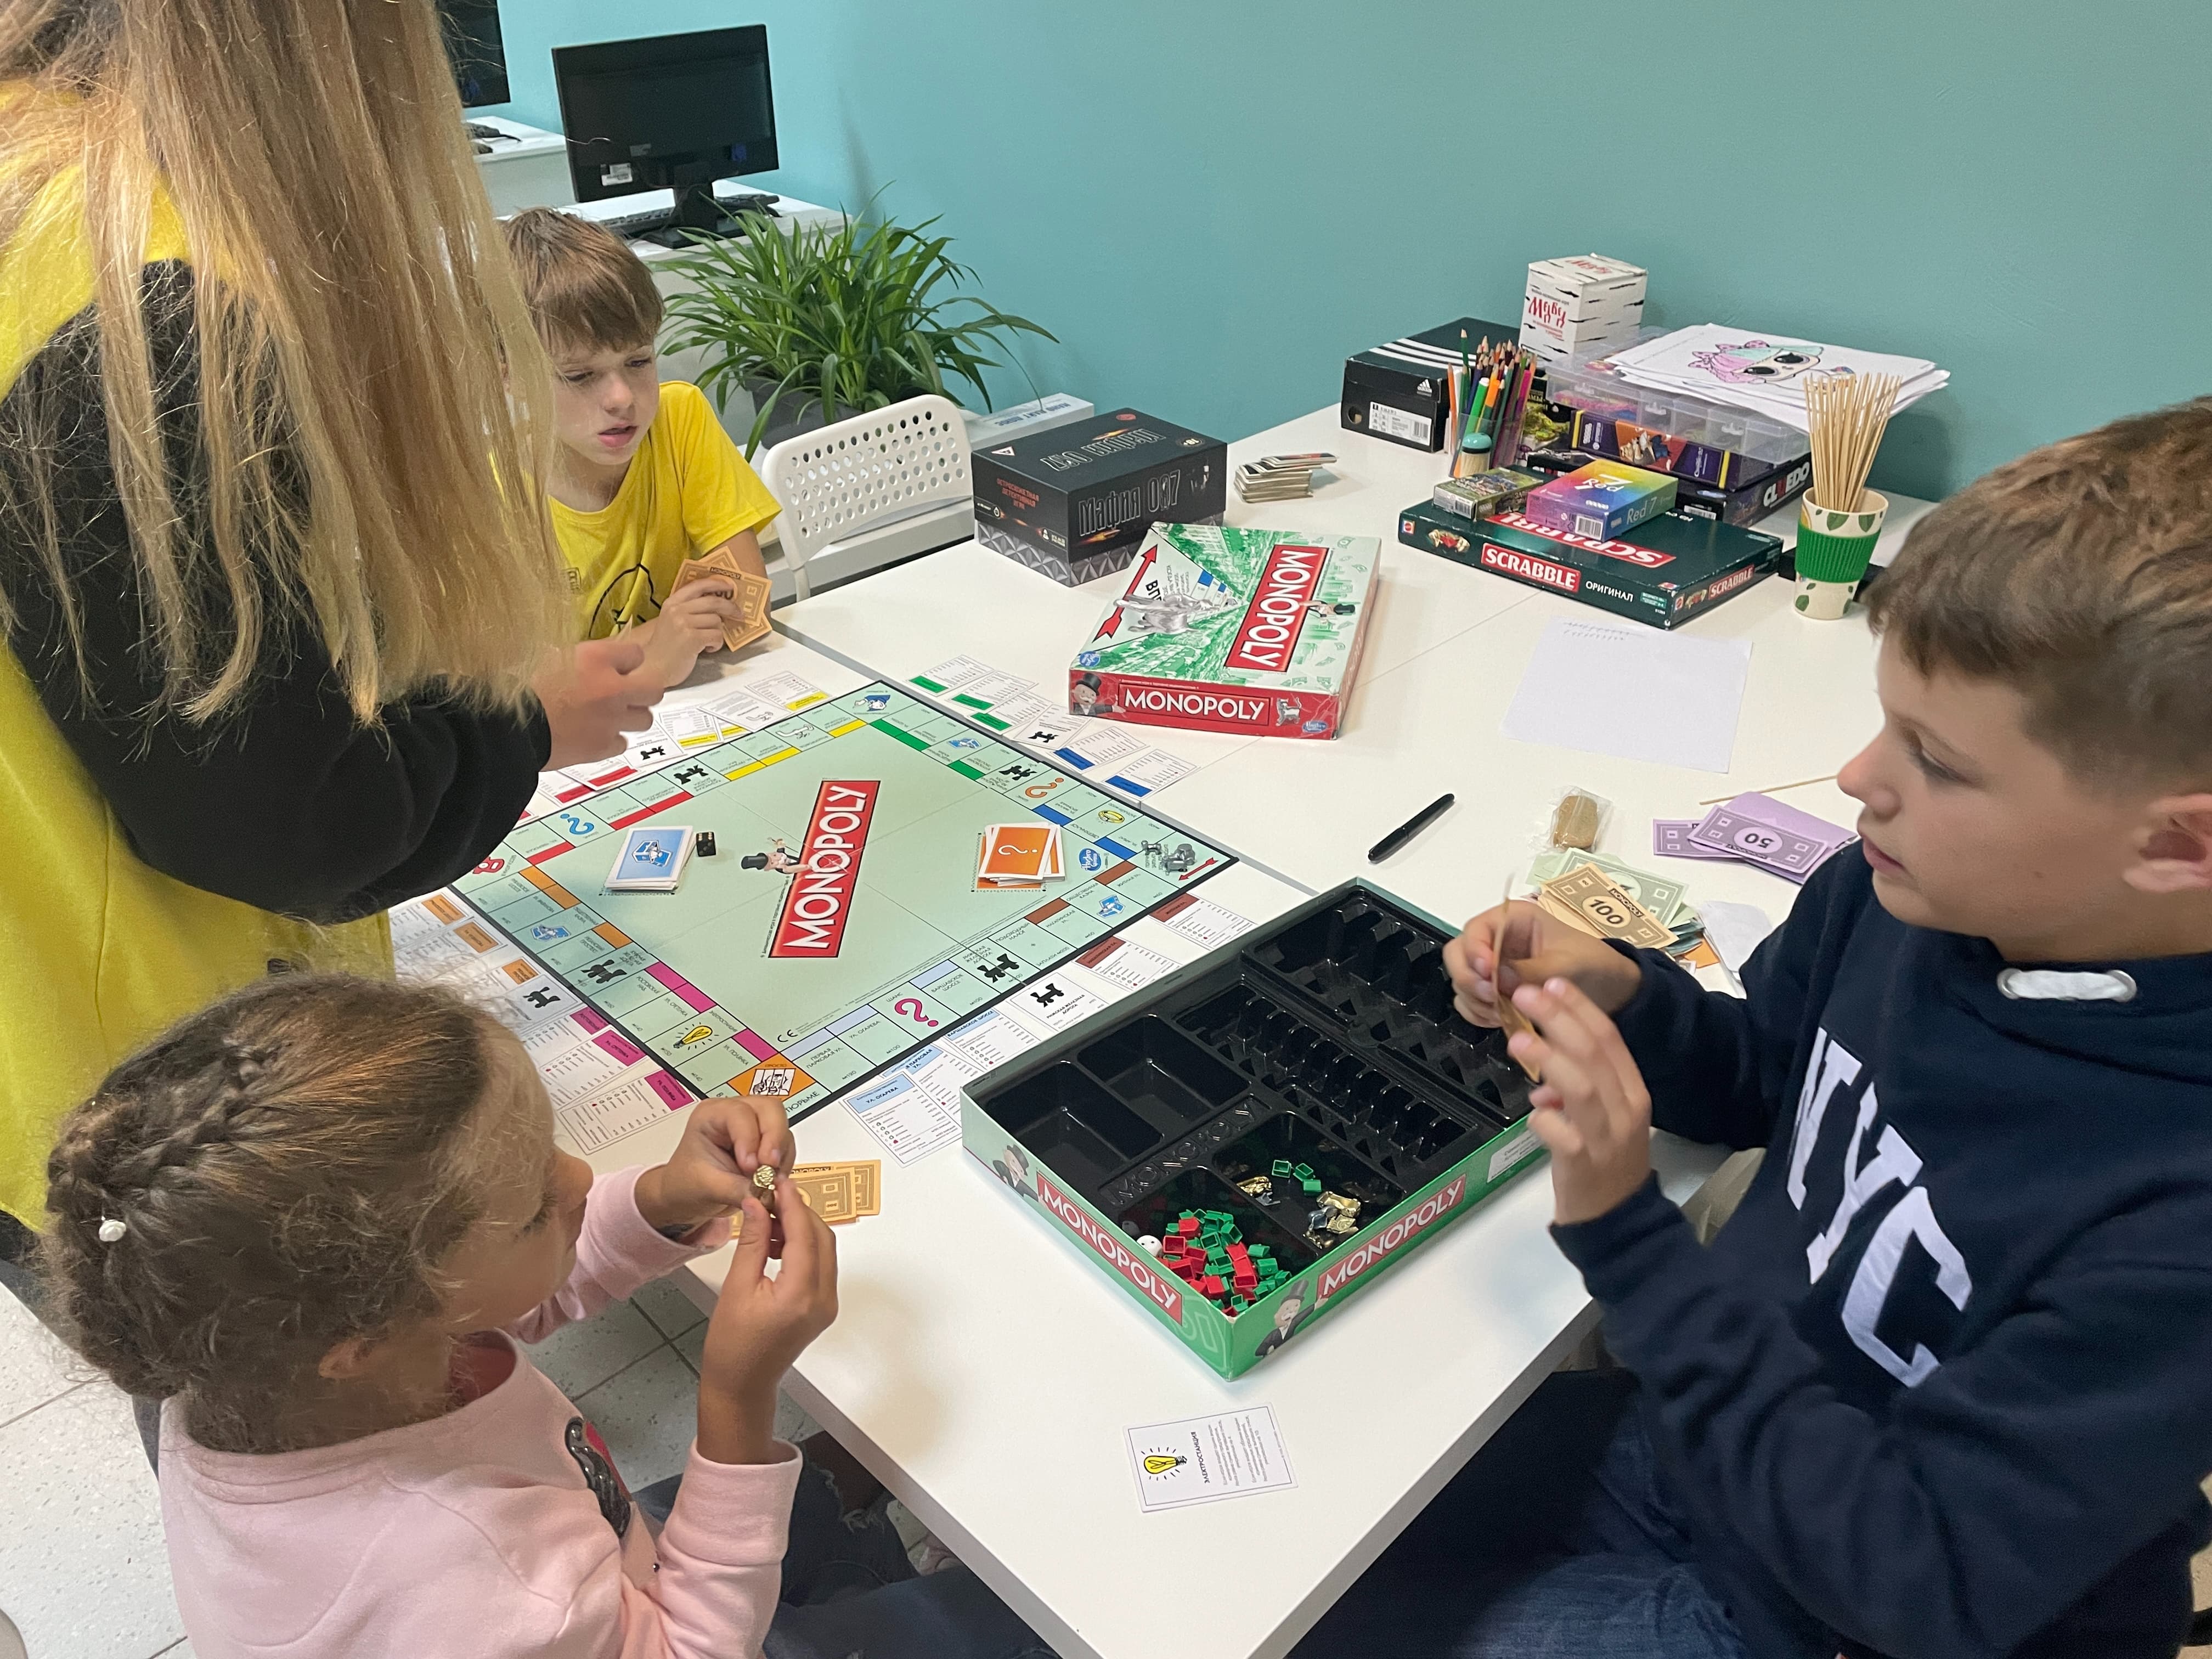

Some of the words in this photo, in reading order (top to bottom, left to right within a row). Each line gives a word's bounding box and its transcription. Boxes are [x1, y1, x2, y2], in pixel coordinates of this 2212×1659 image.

[1079, 487, 1141, 537] Мафия
[1147, 470, 1181, 513] 007
[1626, 499, 1646, 525] Red
[1649, 496, 1658, 515] 7
[712, 568, 741, 579] MONOPOLY
[1486, 548, 1576, 590] SCRABBLE
[1585, 580, 1634, 602] ОРИГИНАЛ
[1710, 567, 1754, 596] SCRABBLE
[1238, 549, 1316, 669] MONOPOLY
[1124, 688, 1265, 721] MONOPOLY
[1745, 833, 1775, 849] 50
[782, 785, 867, 949] MONOPOLY
[1081, 849, 1091, 871] Hasbro
[1589, 899, 1624, 925] 100
[1611, 889, 1642, 917] MONOPOLY
[931, 974, 963, 992] ВАРШАВСКОЕ
[942, 980, 961, 992] ШОССЕ
[886, 992, 904, 1003] ШАНС
[857, 1020, 881, 1035] ОГАРЕВА
[947, 1019, 978, 1037] ВАРШАВСКОЕ
[806, 1051, 836, 1069] ПАРКОВАЯ
[810, 1047, 832, 1061] ПЕРВАЯ
[909, 1048, 933, 1068] ПАРКОВАЯ
[786, 1091, 820, 1113] ТЮРЬМЕ
[875, 1086, 899, 1101] ОГАРЕВА
[1787, 1025, 1973, 1389] NYC
[1045, 1183, 1176, 1308] MONOPOLY
[1324, 1181, 1461, 1295] MONOPOLY
[1191, 1431, 1210, 1483] ЭЛЕКТРОСТАНЦИЯ
